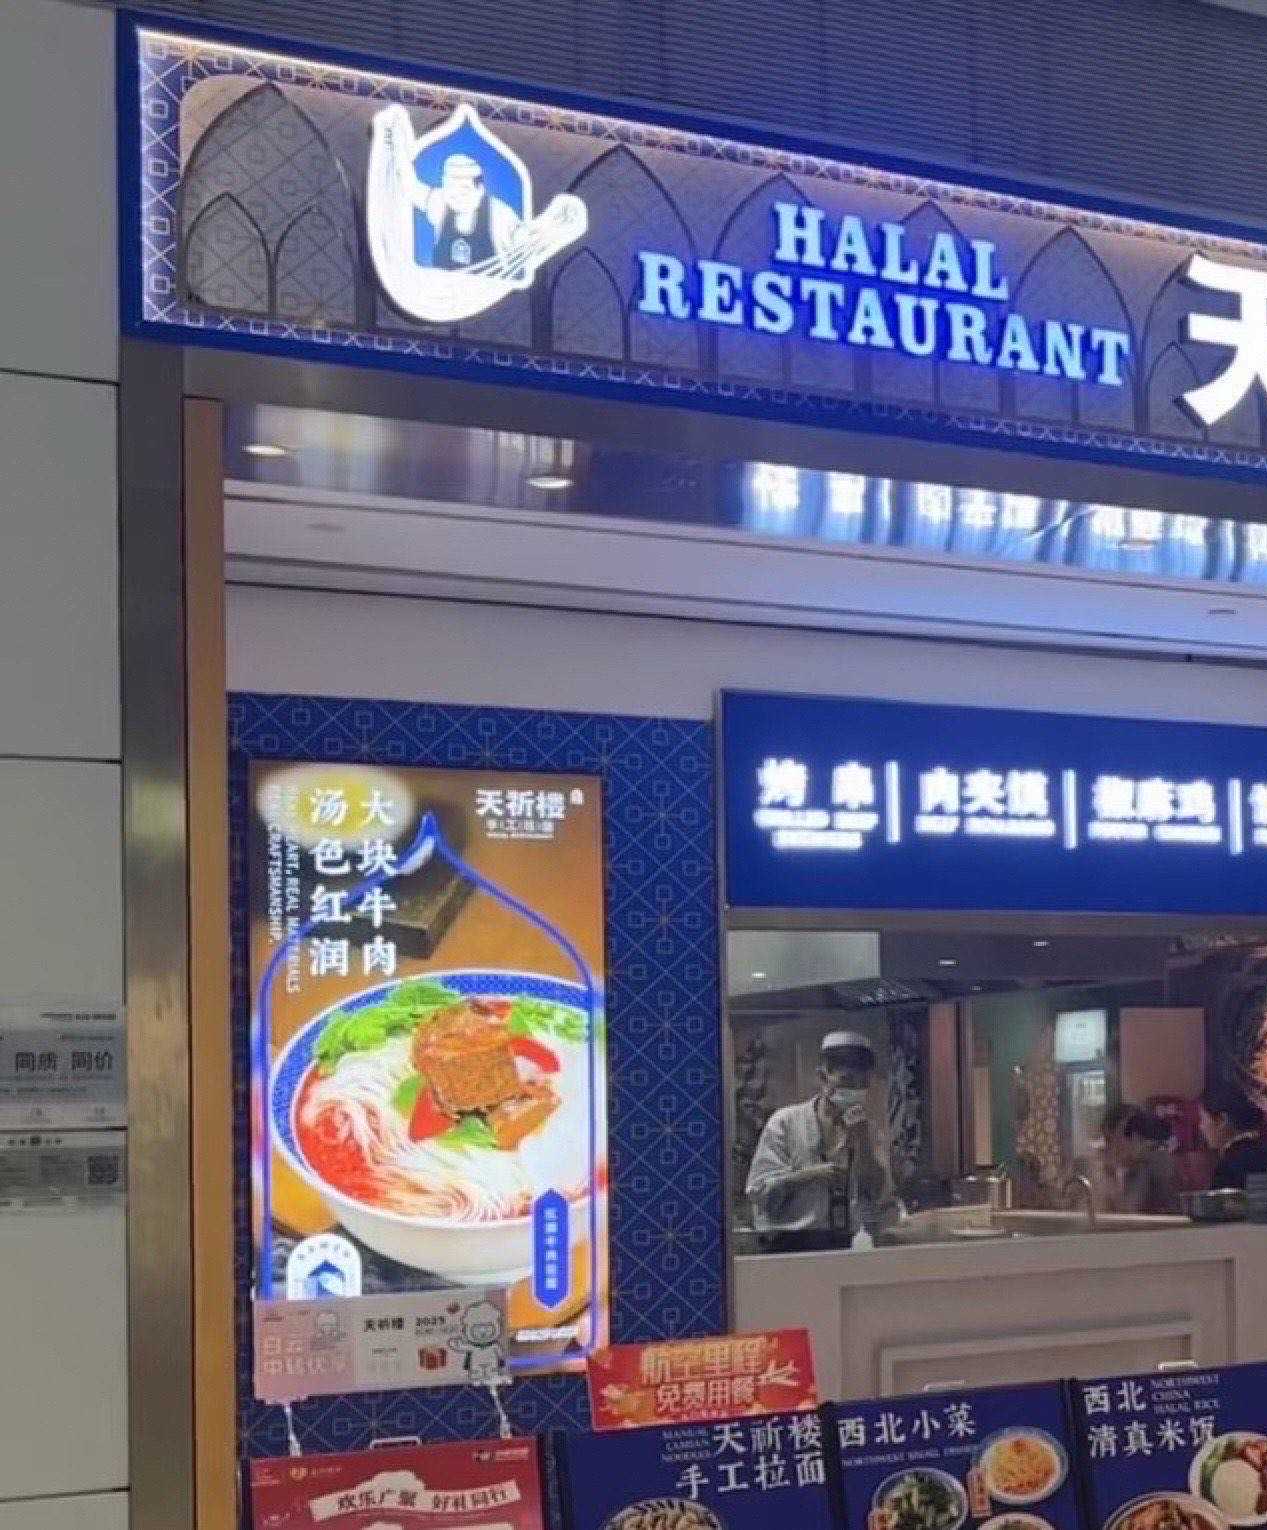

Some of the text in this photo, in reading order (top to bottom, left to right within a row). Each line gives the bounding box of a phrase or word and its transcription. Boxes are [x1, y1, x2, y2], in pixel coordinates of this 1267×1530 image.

[773, 200, 1009, 301] HALAL
[638, 251, 1130, 386] RESTAURANT
[309, 788, 351, 977] 汤色红润
[357, 788, 398, 976] 大块牛肉
[1083, 1380, 1147, 1415] 西北
[713, 1413, 822, 1454] 天祈楼
[837, 1401, 977, 1449] 西北小菜
[1087, 1415, 1216, 1459] 清真米饭
[675, 1451, 826, 1500] 手工拉面
